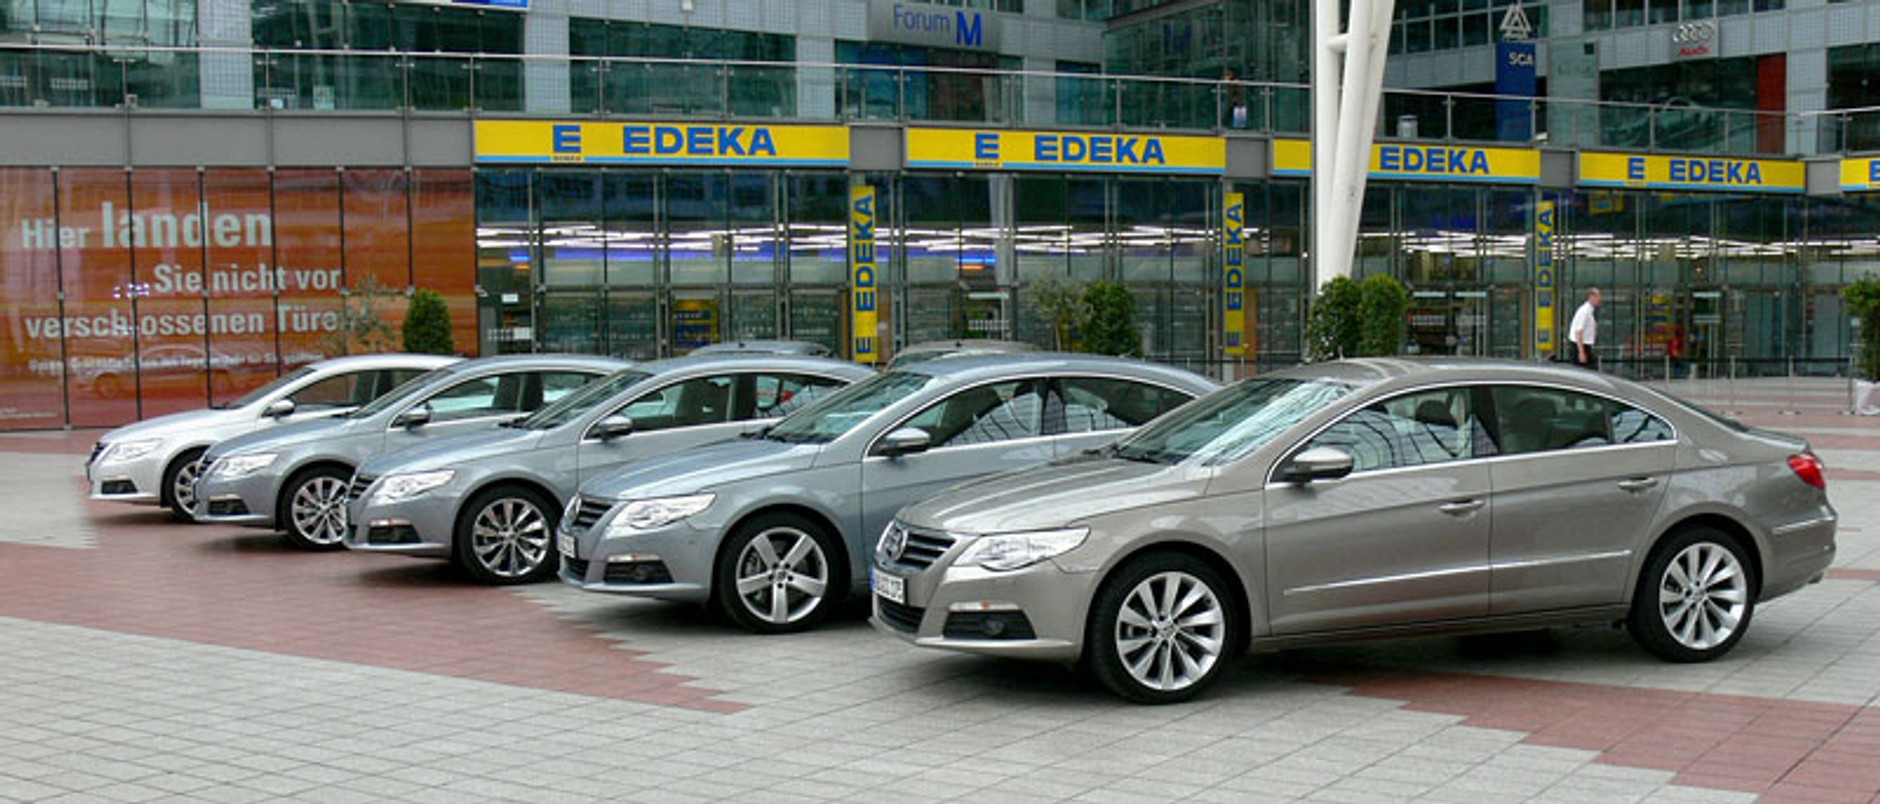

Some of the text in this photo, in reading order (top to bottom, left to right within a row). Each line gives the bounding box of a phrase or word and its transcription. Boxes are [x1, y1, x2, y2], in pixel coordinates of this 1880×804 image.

[893, 4, 982, 46] Forum M
[1508, 51, 1534, 66] SCA
[553, 125, 777, 156] E EDEKA
[975, 132, 1165, 164] E EDEKA
[1379, 146, 1490, 175] EDEKA
[1628, 157, 1762, 184] E EDEKA
[21, 201, 272, 249] Hier landen
[855, 195, 875, 354] E EDEKA
[1538, 210, 1553, 307] EDEKA
[154, 262, 342, 293] Sie nicht vor
[1227, 204, 1242, 347] E EDEKA
